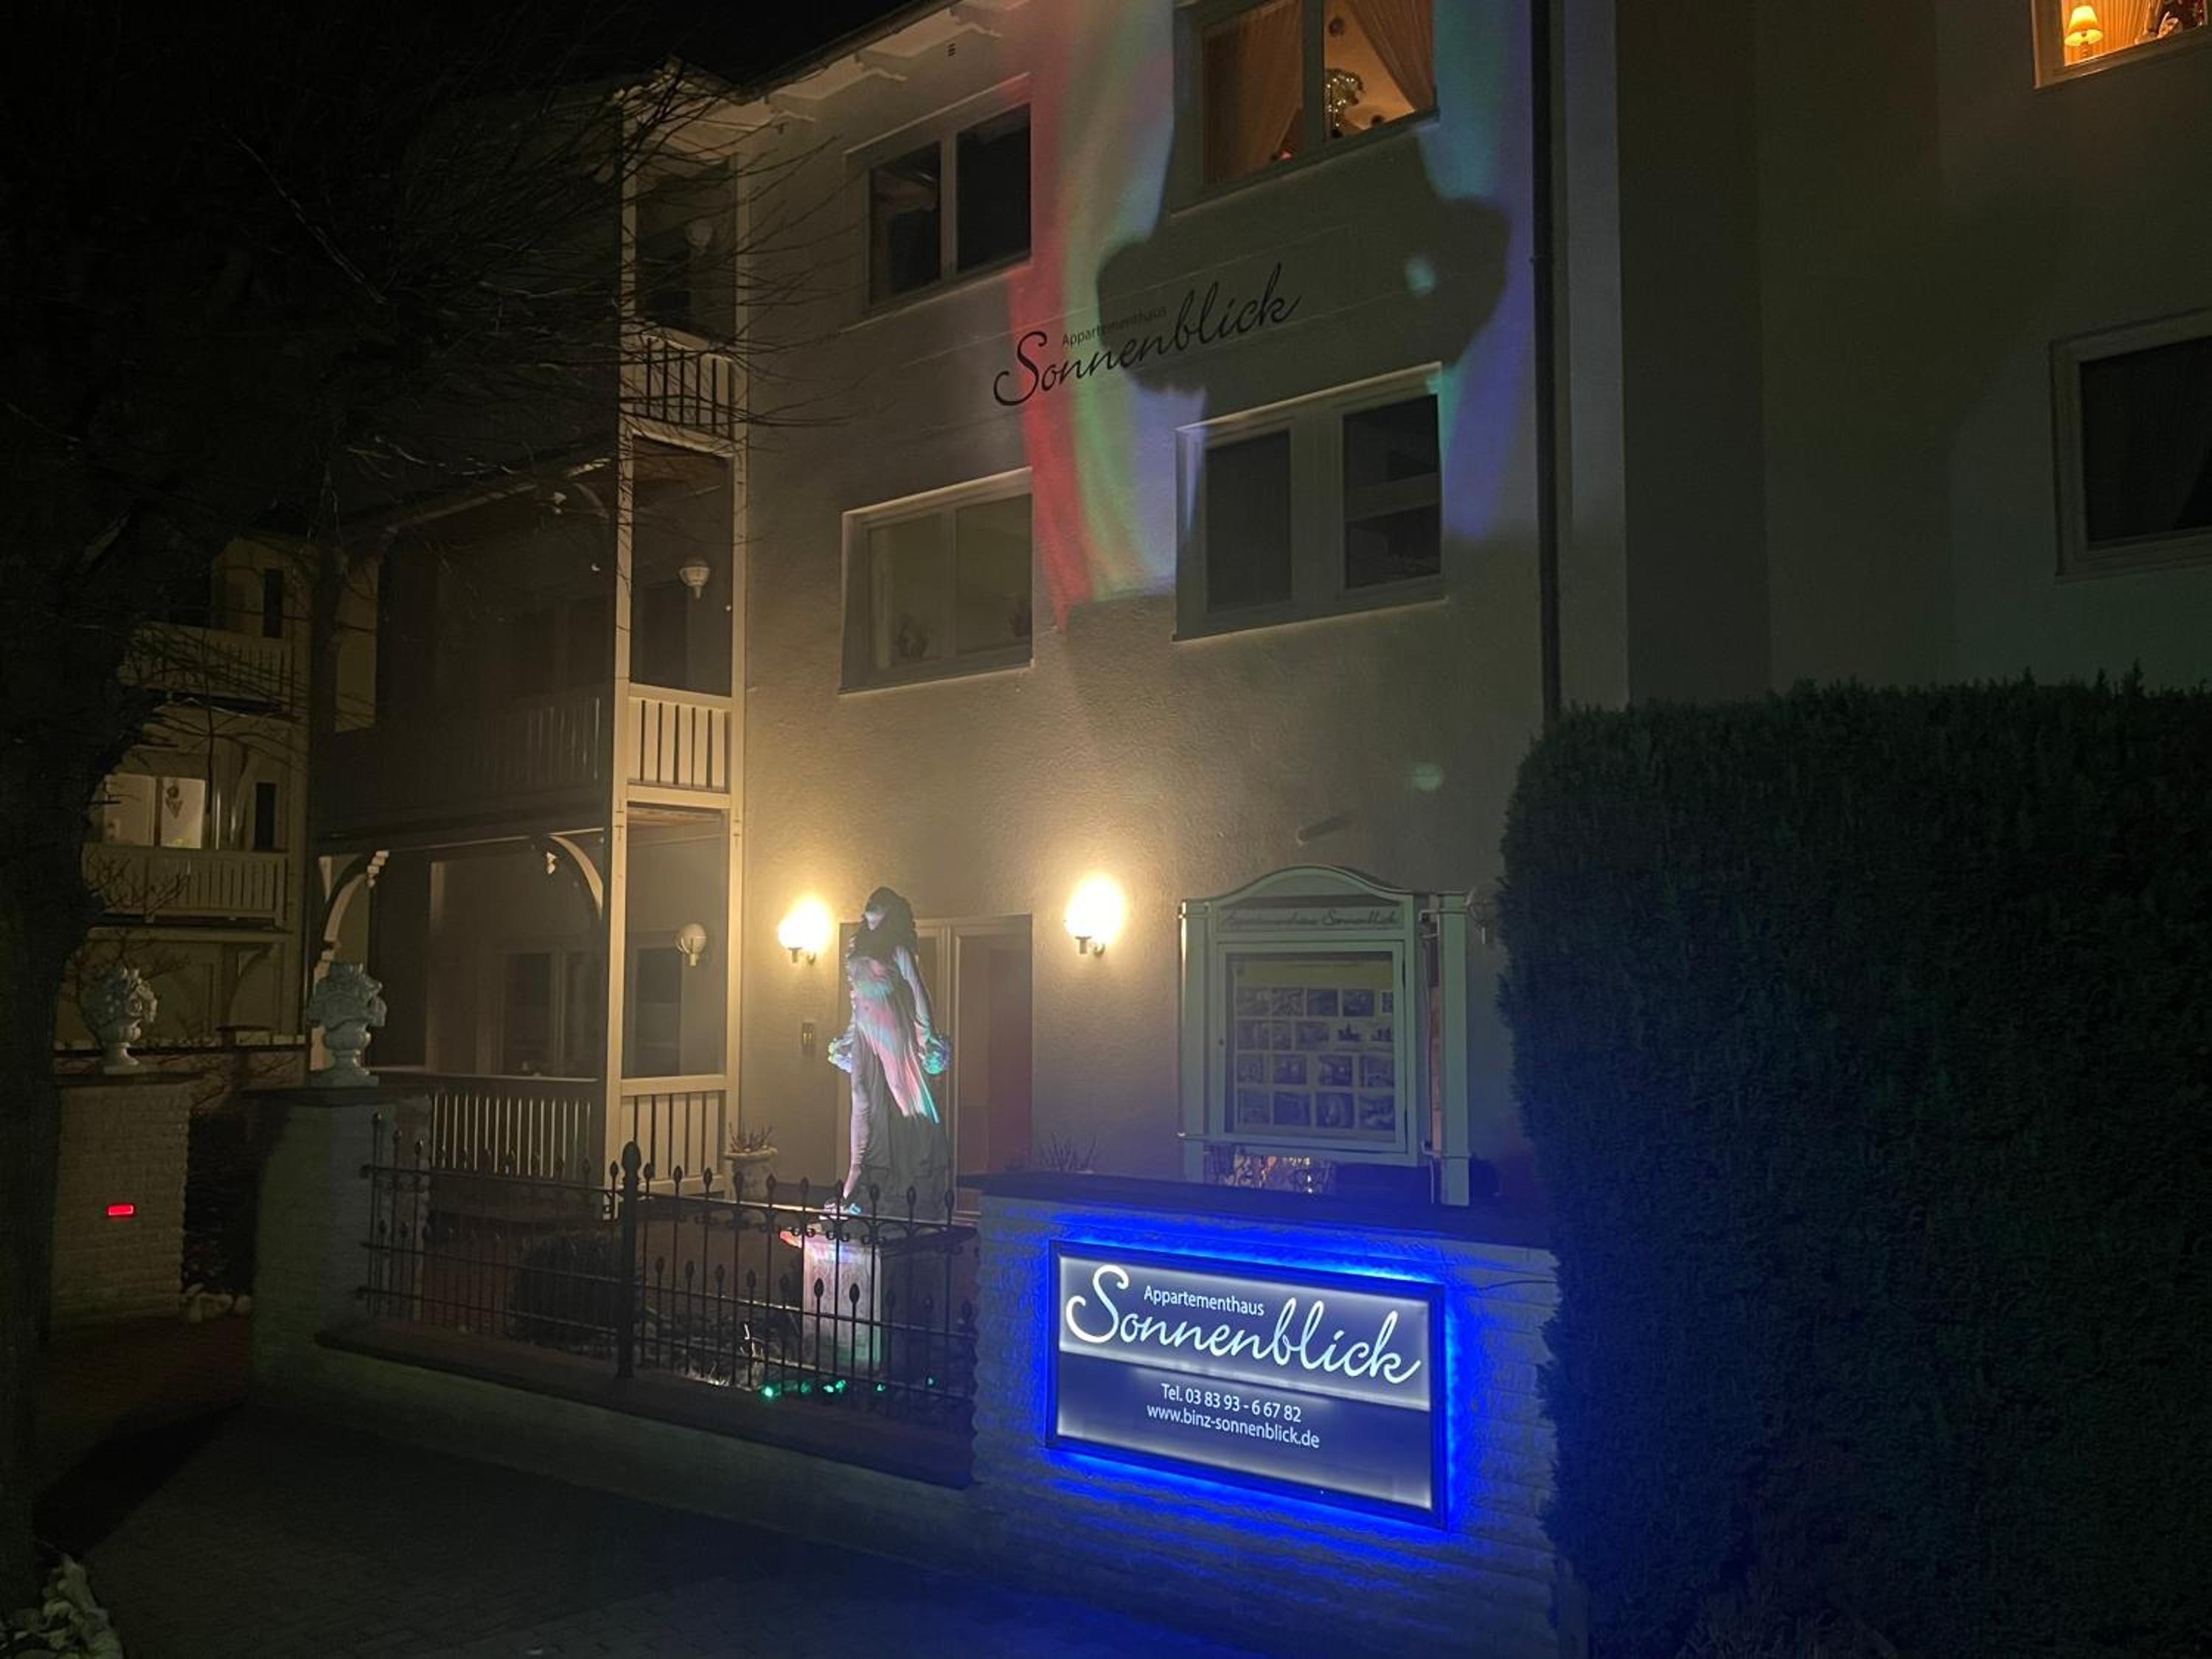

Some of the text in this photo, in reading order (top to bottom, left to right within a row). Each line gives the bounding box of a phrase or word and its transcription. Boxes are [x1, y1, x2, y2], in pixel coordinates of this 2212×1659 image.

[992, 261, 1301, 406] Sonnenblick
[1144, 1284, 1265, 1316] Appartementhaus
[1065, 1264, 1422, 1384] Sonnenblick
[1161, 1382, 1183, 1402] Tel.
[1185, 1388, 1201, 1405] 03
[1204, 1391, 1221, 1408] 83
[1223, 1394, 1240, 1412] 93
[1251, 1399, 1260, 1416] 6
[1263, 1402, 1281, 1418] 67
[1283, 1405, 1301, 1422] 82
[1147, 1404, 1321, 1449] www.binz-sonnenblick.de
